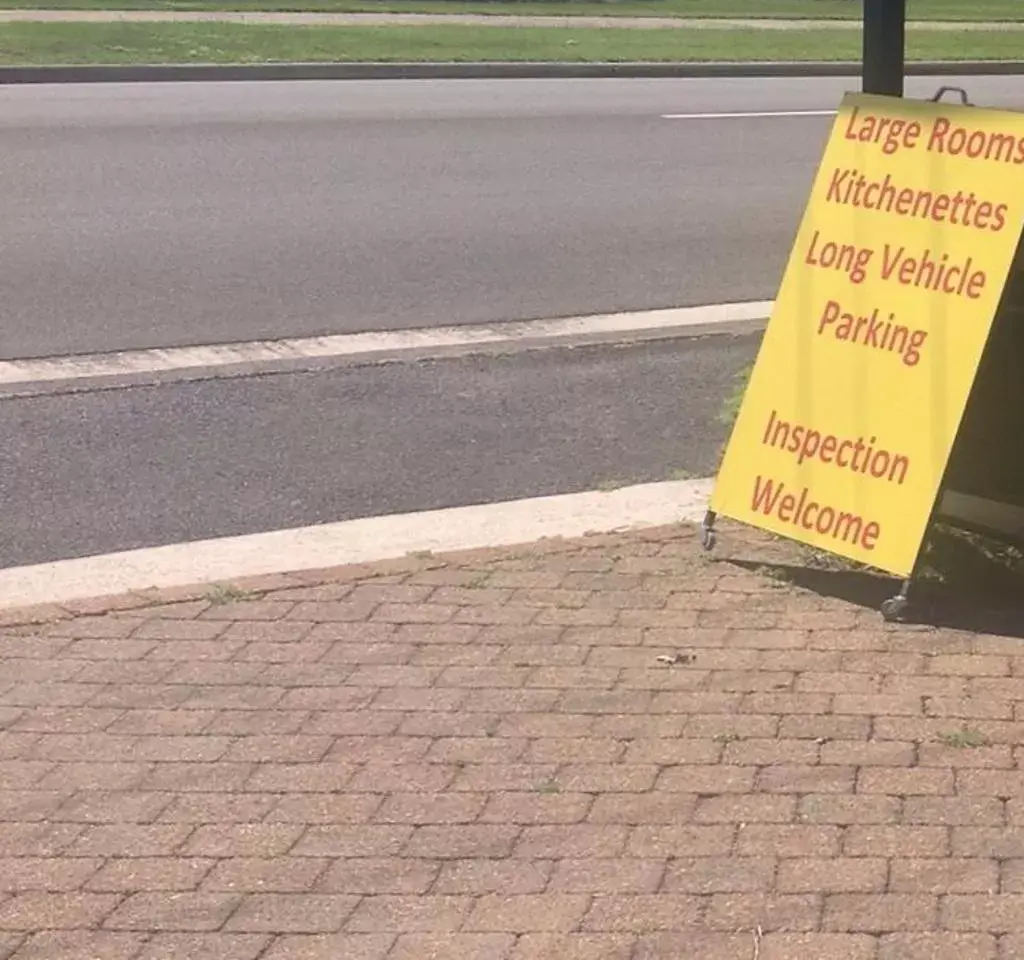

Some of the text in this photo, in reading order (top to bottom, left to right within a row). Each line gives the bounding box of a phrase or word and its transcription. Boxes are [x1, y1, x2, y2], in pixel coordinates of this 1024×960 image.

[845, 106, 920, 155] Large
[827, 167, 1008, 233] Kitchenettes
[805, 230, 874, 284] Long
[880, 244, 986, 300] Vehicle
[818, 300, 928, 367] Parking
[762, 410, 909, 484] Inspection
[750, 476, 880, 551] Welcome
